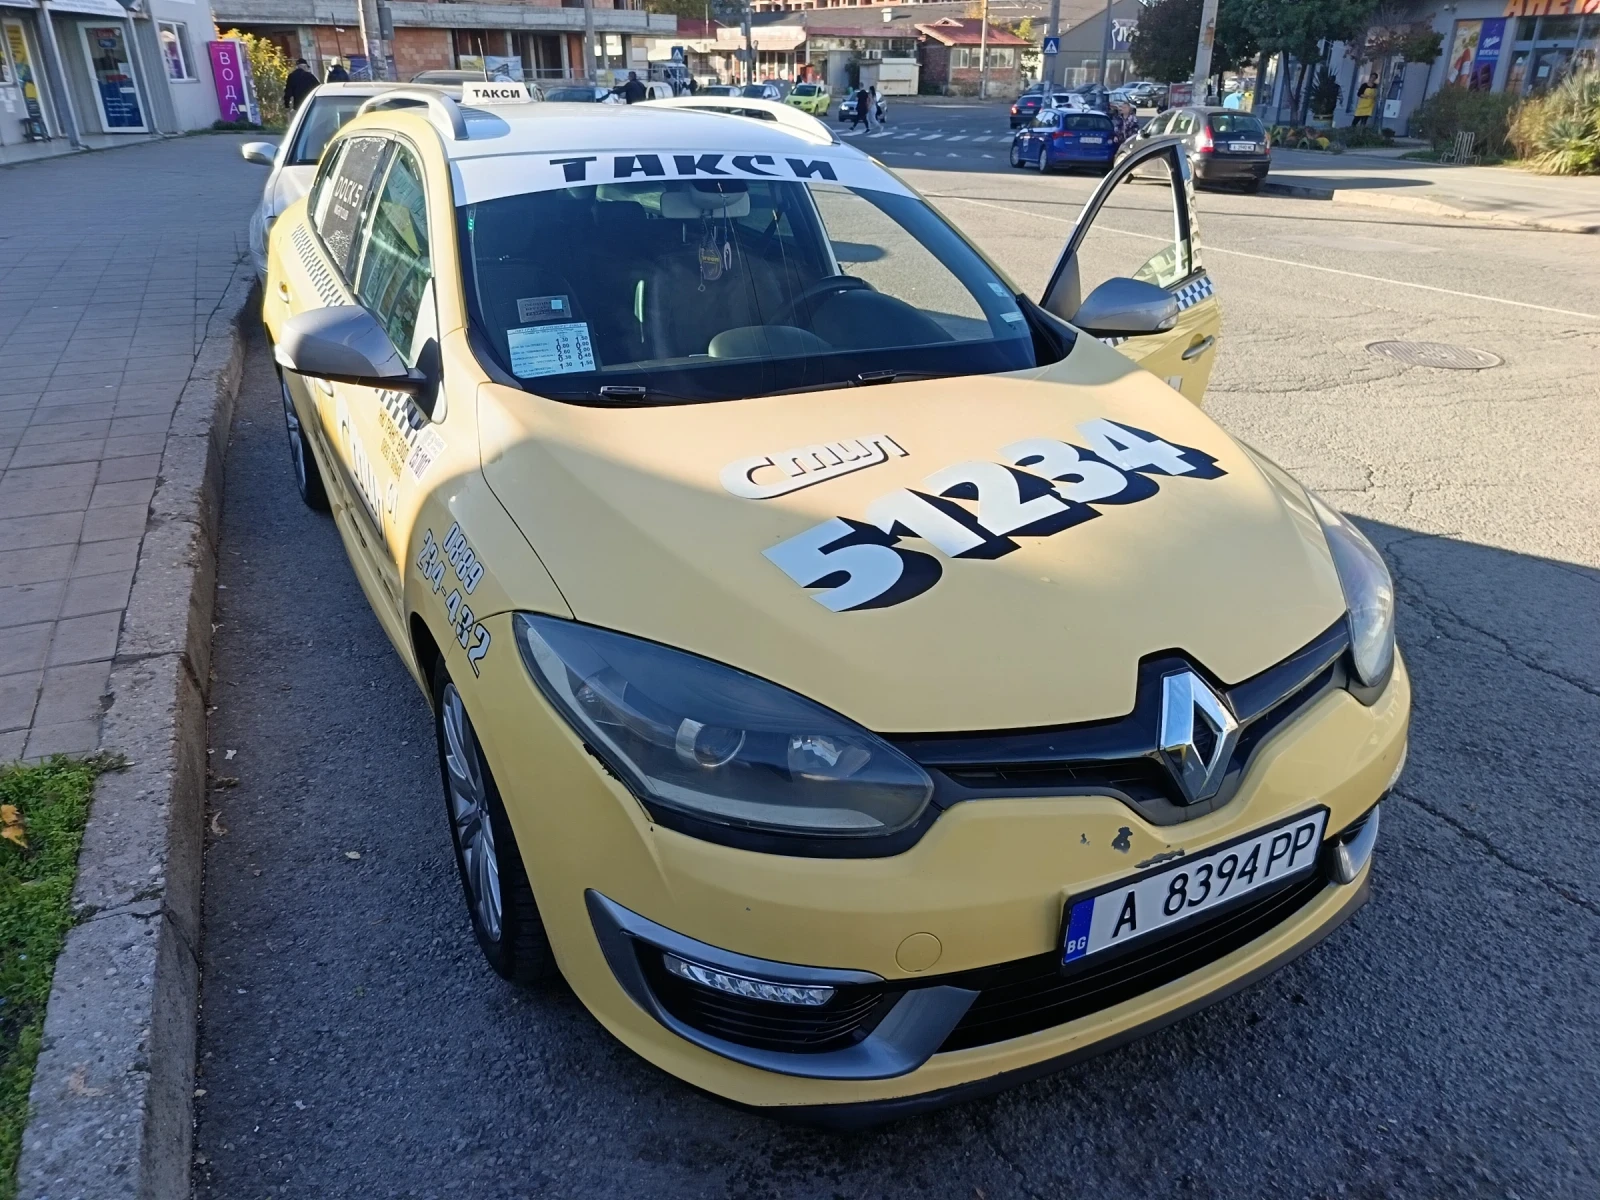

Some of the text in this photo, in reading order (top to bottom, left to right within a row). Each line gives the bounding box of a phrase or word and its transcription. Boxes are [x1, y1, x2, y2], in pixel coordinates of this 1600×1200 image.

[219, 52, 240, 115] ВОДА
[473, 89, 521, 98] ТАКСИ
[550, 154, 838, 182] ТАКСИ
[761, 418, 1228, 613] 51234
[442, 521, 484, 595] 0889
[416, 528, 492, 679] 234-432
[1111, 890, 1137, 938] A
[1066, 935, 1087, 954] BG
